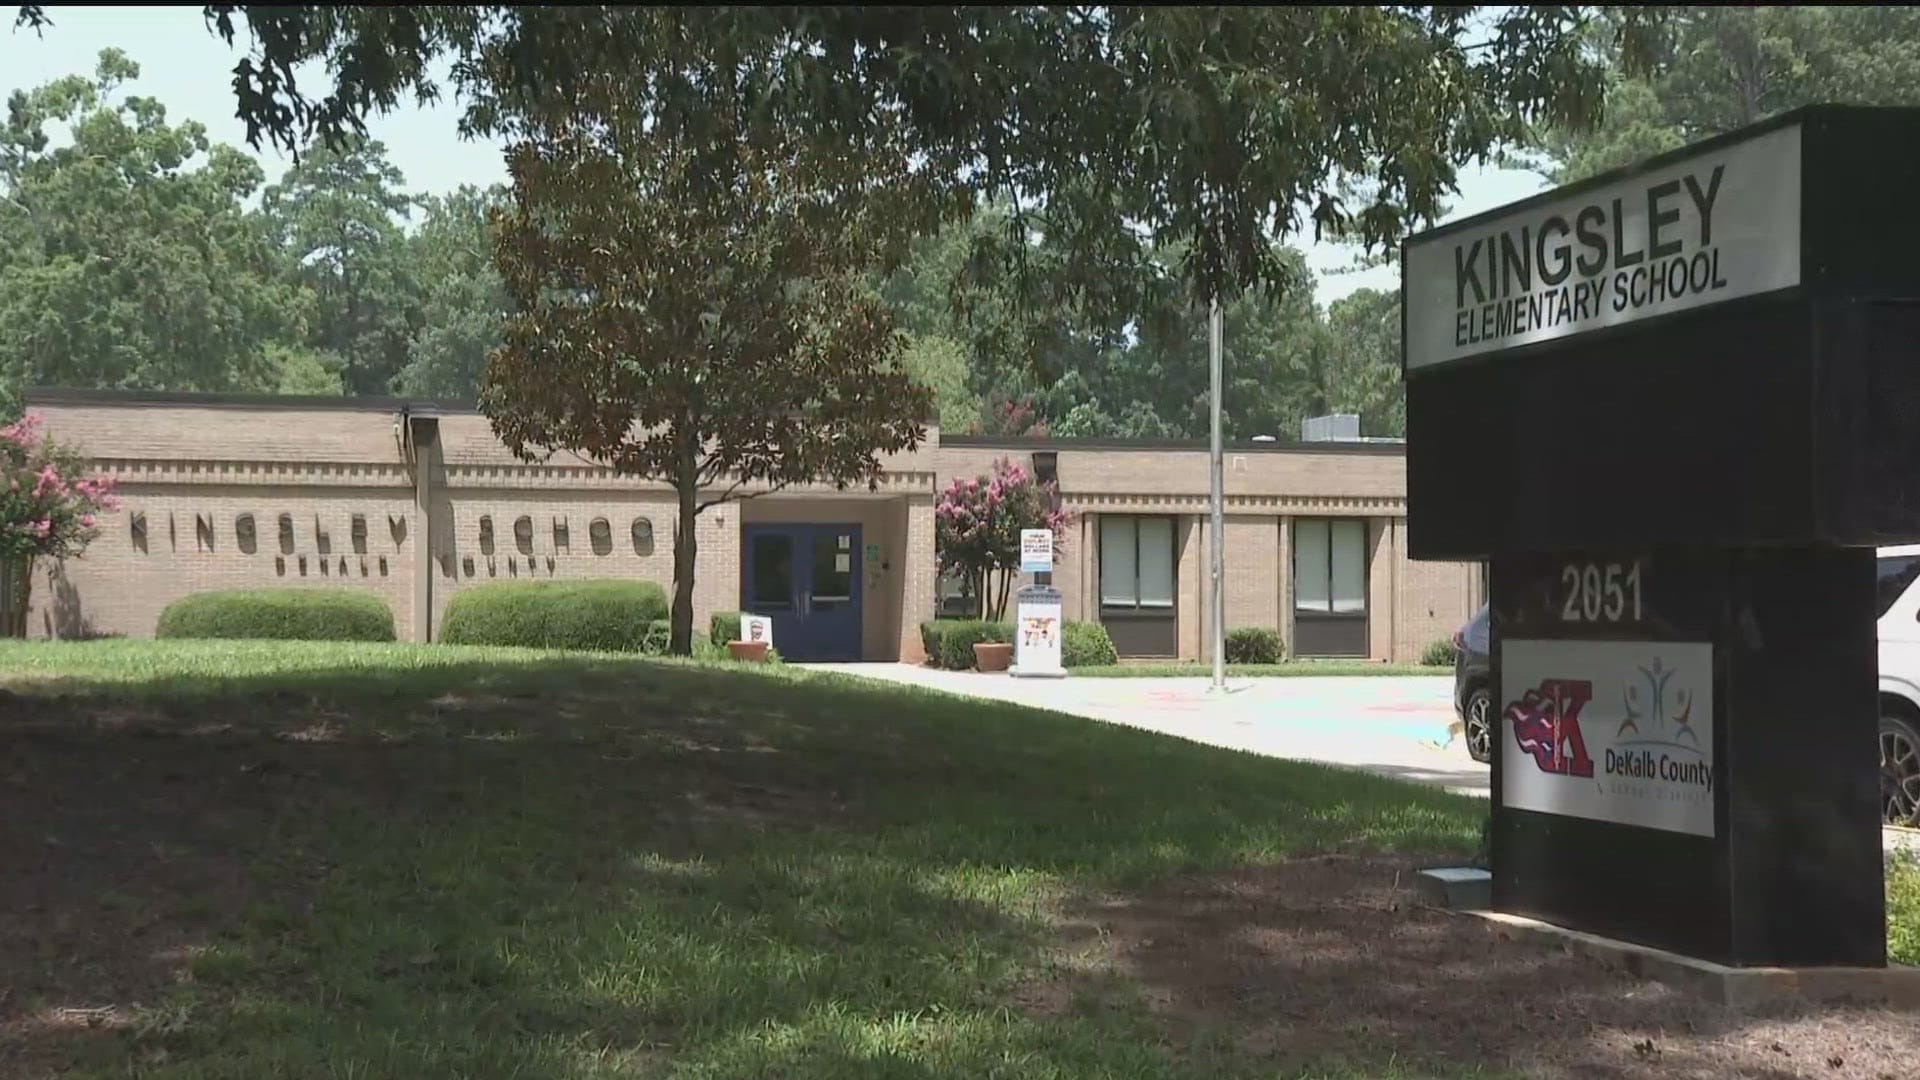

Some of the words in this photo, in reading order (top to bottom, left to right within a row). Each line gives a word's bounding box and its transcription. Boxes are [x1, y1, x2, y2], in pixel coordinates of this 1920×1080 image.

[1456, 165, 1724, 307] KINGSLEY
[1456, 277, 1609, 346] ELEMENTARY
[1612, 248, 1727, 312] SCHOOL
[131, 511, 408, 555] KINGSLEY
[1562, 563, 1643, 621] 2051
[1606, 748, 1657, 780] DeKalb
[1660, 755, 1713, 793] County
